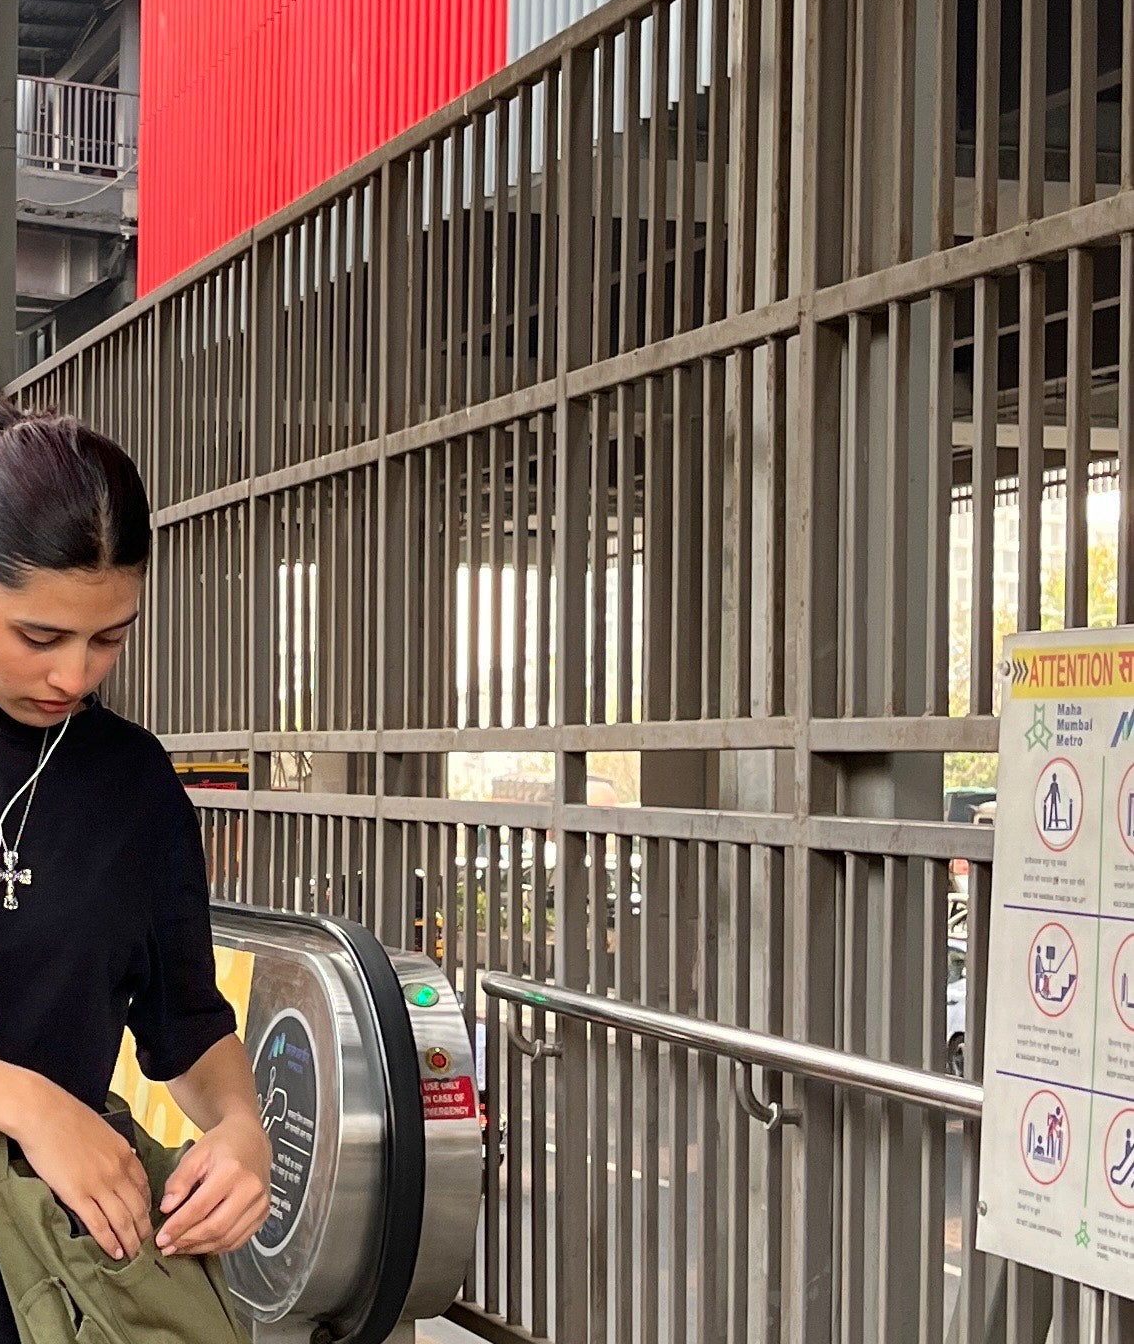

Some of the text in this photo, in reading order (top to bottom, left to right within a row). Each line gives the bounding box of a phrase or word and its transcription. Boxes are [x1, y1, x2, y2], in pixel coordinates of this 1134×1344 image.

[1029, 652, 1113, 688] ATTENTION
[1057, 703, 1082, 716] Maha
[1056, 718, 1093, 731] Mumbai
[1056, 734, 1083, 747] Metro
[423, 1080, 460, 1092] USE ONLY
[432, 1093, 454, 1103] CASE
[453, 1092, 465, 1103] OF
